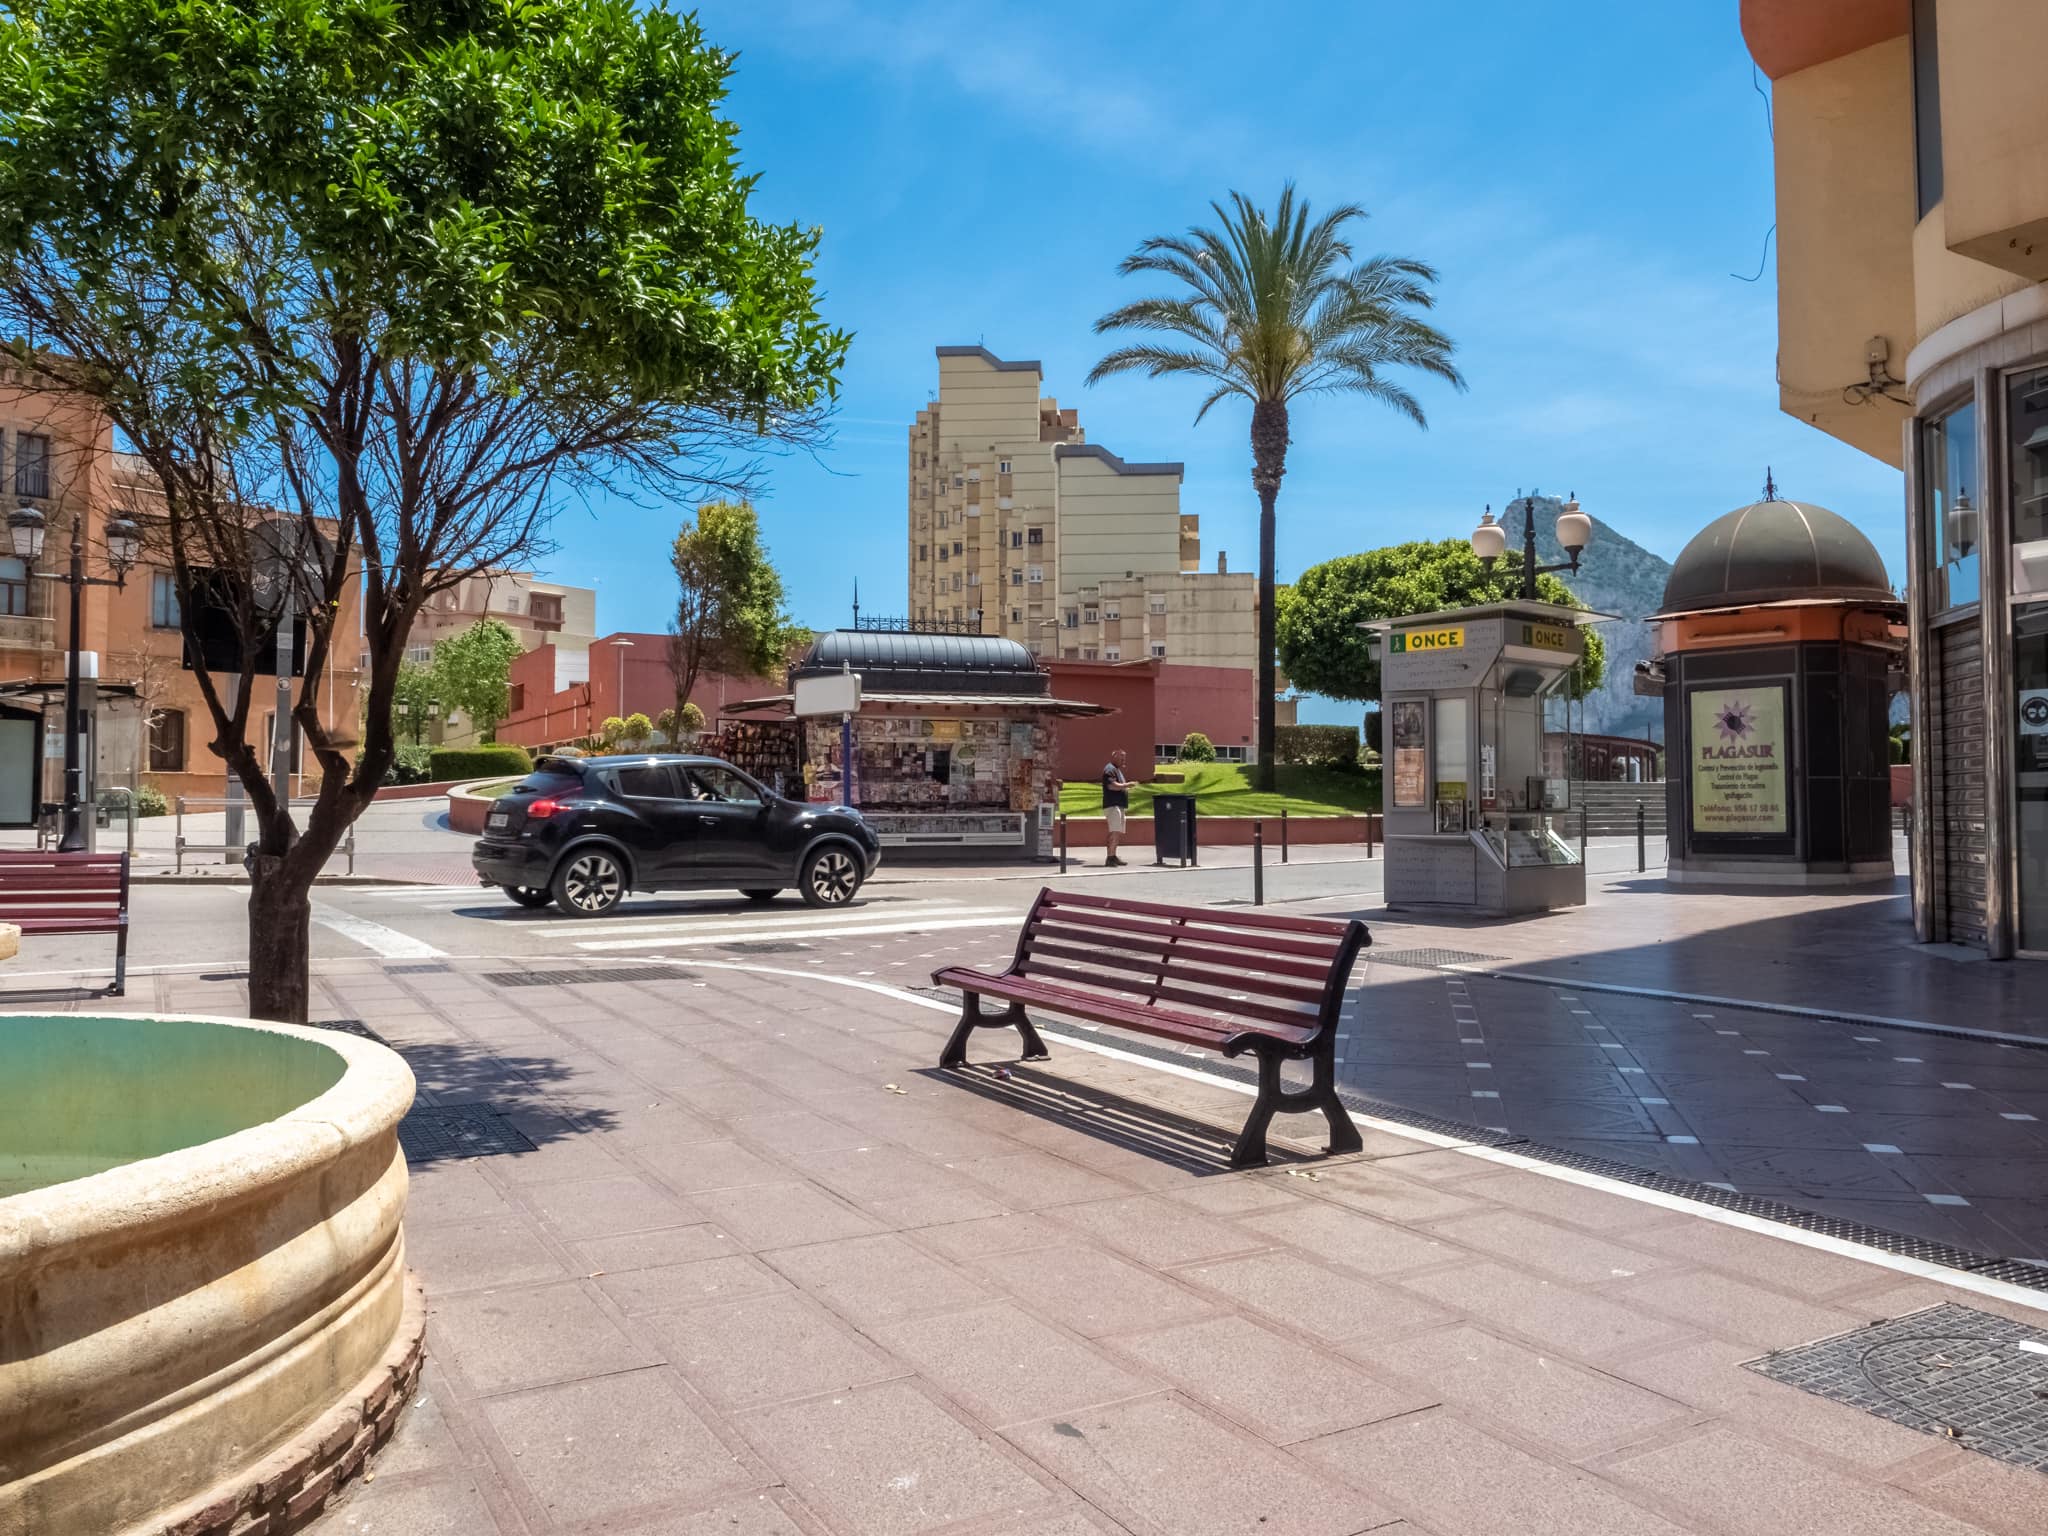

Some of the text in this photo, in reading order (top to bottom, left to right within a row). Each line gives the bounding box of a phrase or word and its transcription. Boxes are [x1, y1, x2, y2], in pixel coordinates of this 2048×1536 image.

[1412, 632, 1458, 648] ONCE
[1536, 631, 1563, 646] ONCE
[1703, 745, 1775, 759] PLAGASUR
